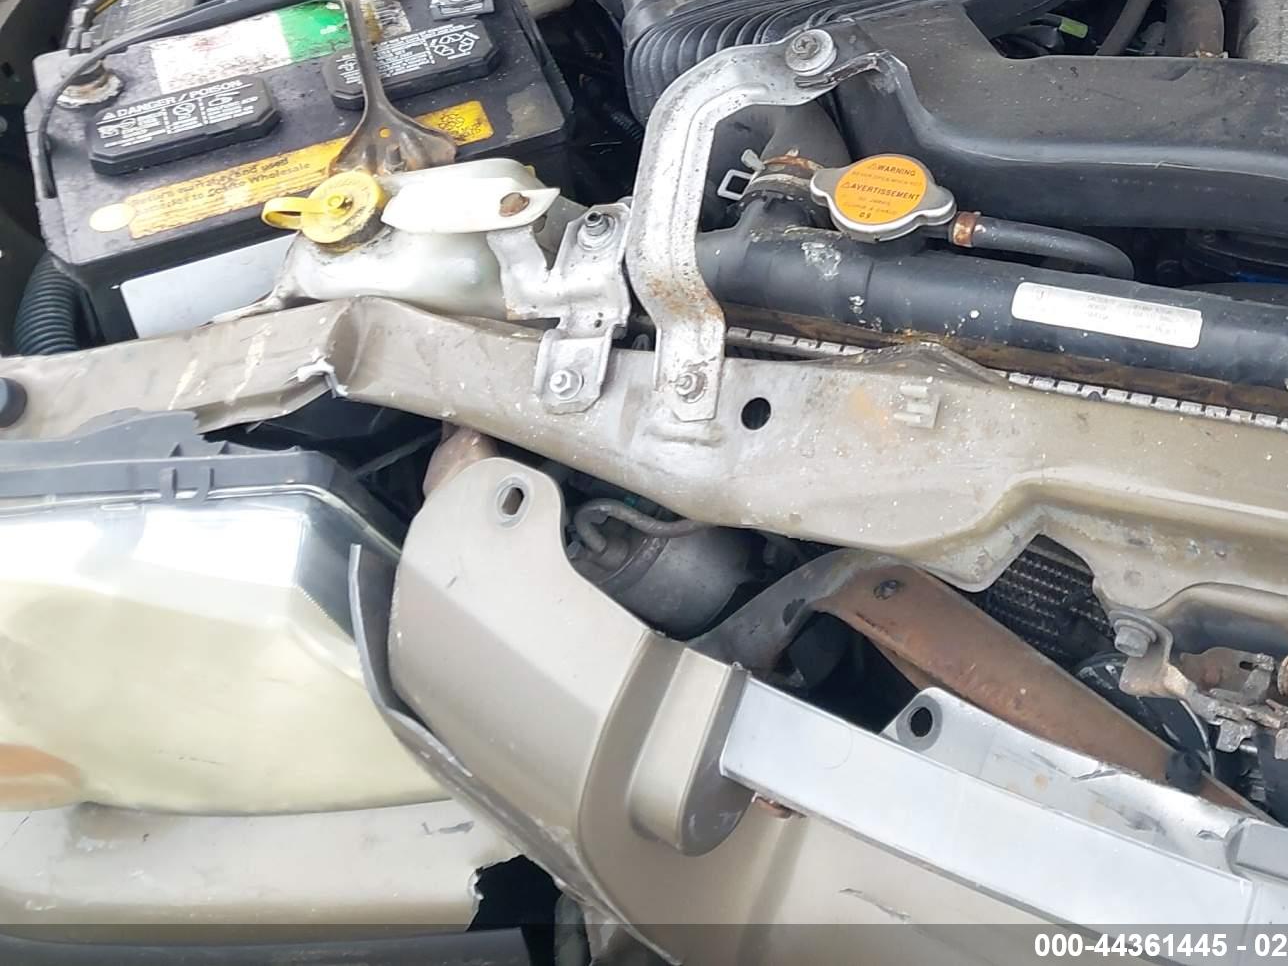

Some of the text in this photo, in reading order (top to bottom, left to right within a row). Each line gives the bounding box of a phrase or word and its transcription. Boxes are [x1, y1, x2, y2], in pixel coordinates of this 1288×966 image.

[116, 96, 176, 117] DANGER
[189, 80, 243, 99] POISON
[248, 162, 311, 184] Wholesale
[877, 164, 916, 177] WARNING
[850, 182, 920, 201] AVERTISSEMENT
